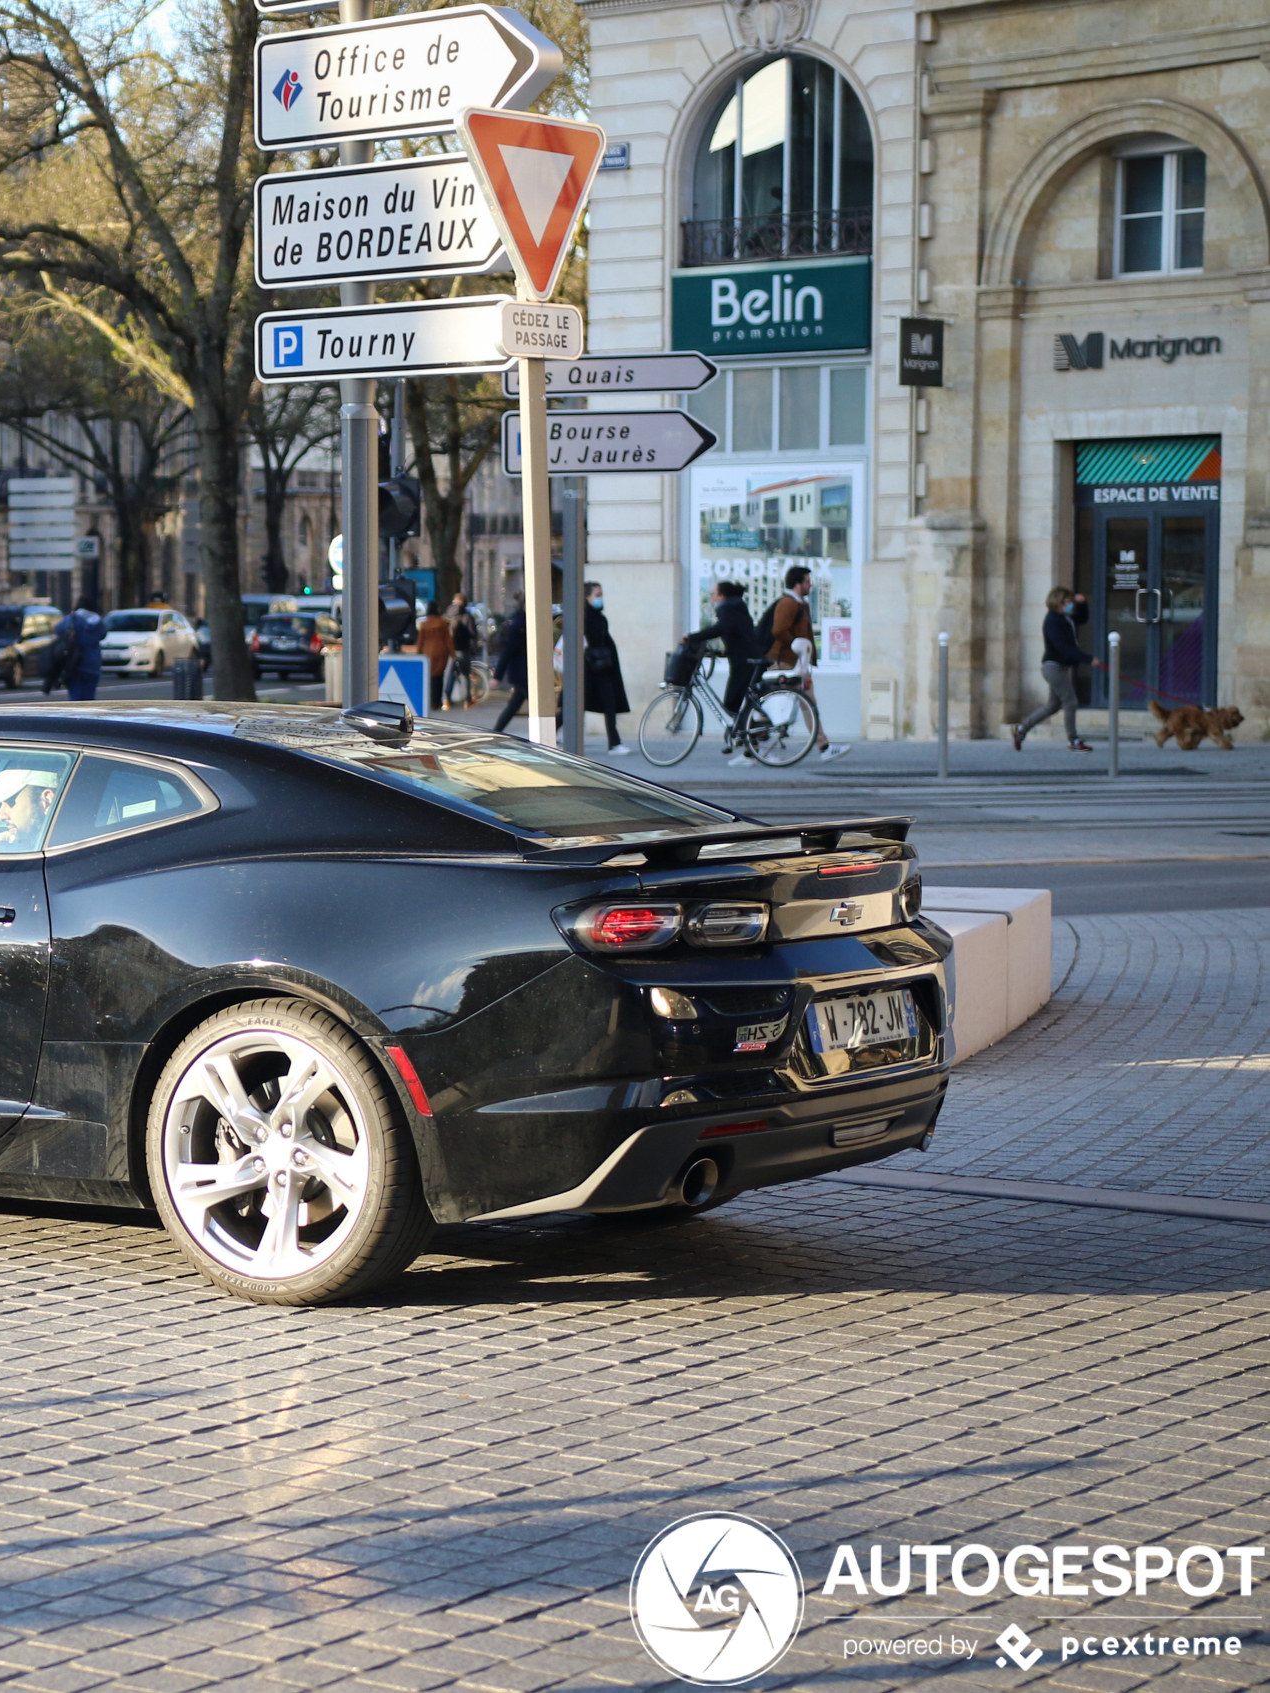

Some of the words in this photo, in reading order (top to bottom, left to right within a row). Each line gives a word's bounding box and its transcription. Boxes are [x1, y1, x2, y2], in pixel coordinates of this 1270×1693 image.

[314, 44, 405, 80] Office
[427, 34, 460, 66] de
[317, 84, 451, 122] Tourisme
[272, 191, 369, 226] Maison
[384, 183, 415, 215] du
[432, 176, 476, 210] Vin
[273, 237, 303, 267] de
[316, 217, 478, 263] BORDEAUX
[711, 273, 823, 326] Belin
[512, 309, 550, 328] CÉDEZ
[557, 316, 570, 330] LE
[515, 331, 568, 349] PASSAGE
[712, 323, 823, 343] promotion
[278, 330, 298, 365] P
[317, 329, 416, 361] Tourny
[1109, 333, 1221, 363] Marignan
[568, 364, 635, 385] Quais
[903, 358, 939, 372] Marignan
[549, 422, 631, 441] Bourse
[550, 446, 568, 464] J.
[578, 445, 657, 464] Jaurès
[1093, 487, 1145, 503] ESPACE
[1148, 487, 1168, 502] DE
[1171, 486, 1219, 501] VENTE
[247, 1016, 283, 1027] EAGLE
